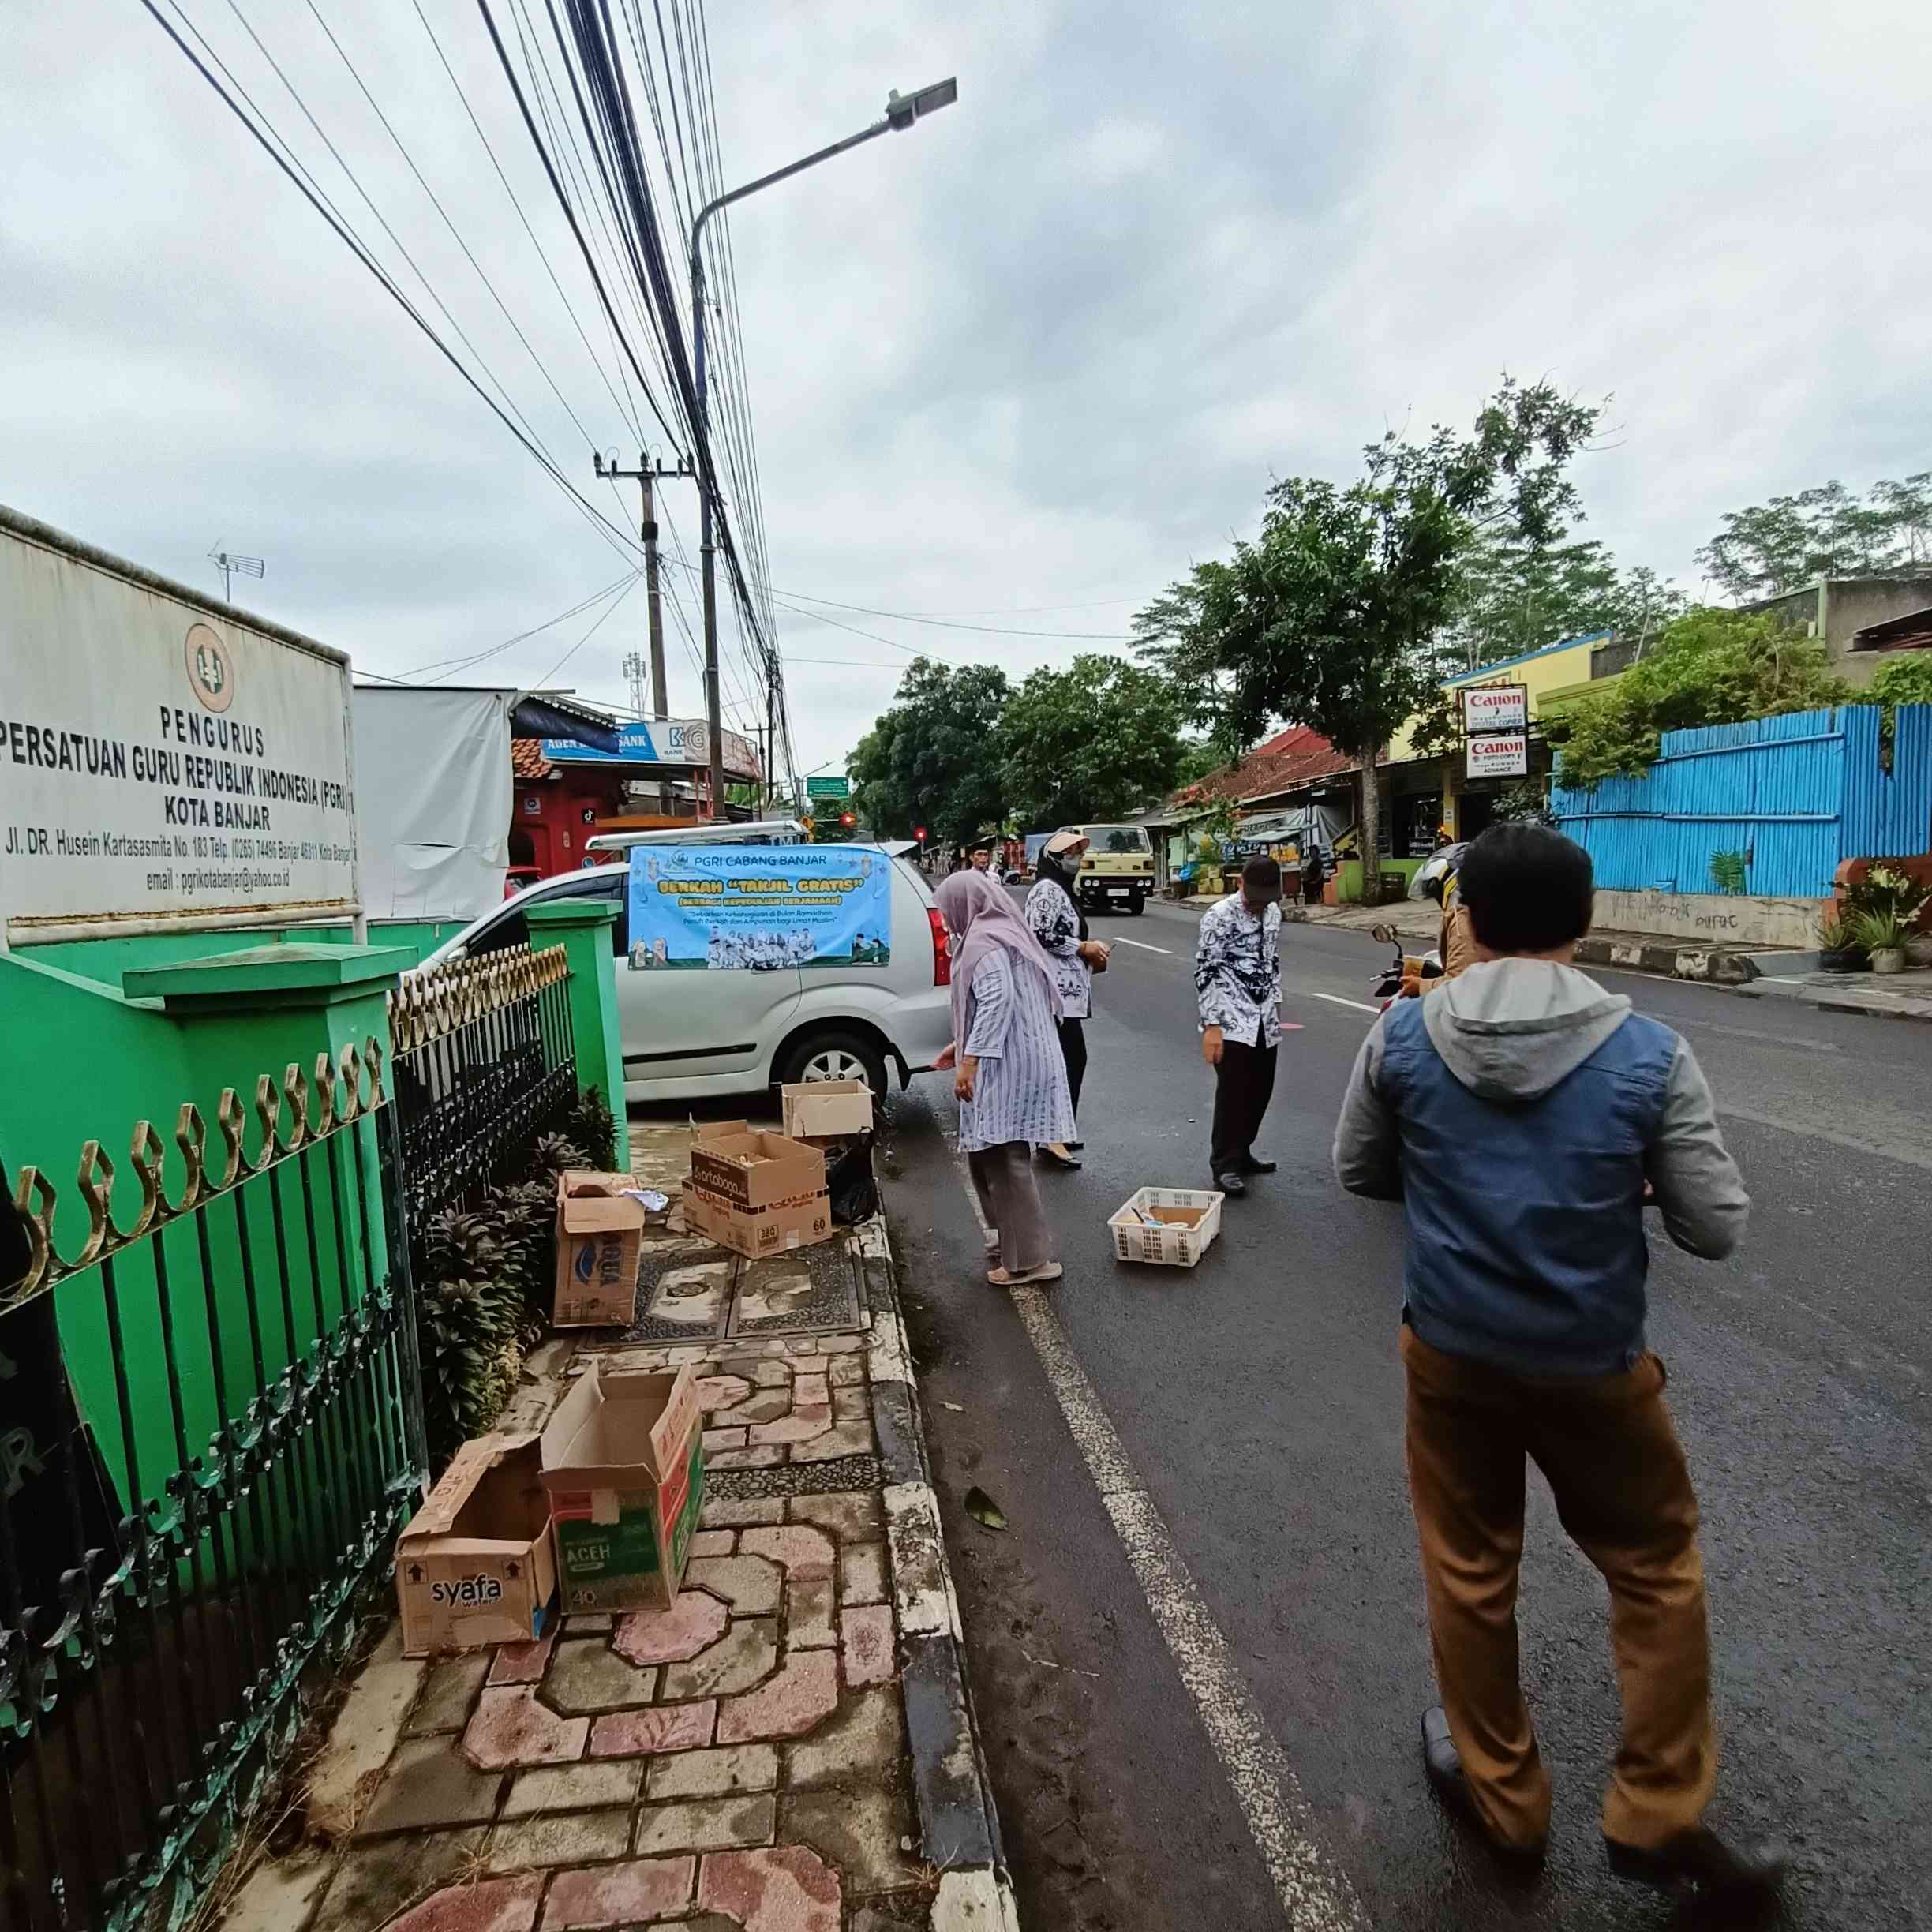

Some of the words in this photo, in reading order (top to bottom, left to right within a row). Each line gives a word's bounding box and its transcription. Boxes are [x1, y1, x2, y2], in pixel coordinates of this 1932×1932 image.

[1470, 695, 1522, 706] Canon
[160, 706, 264, 758] PENGURUS
[1471, 742, 1523, 754] Canon
[132, 745, 181, 787] GURU
[185, 754, 256, 796] REPUBLIK
[257, 767, 319, 806] INDONESIA
[164, 795, 211, 827] KOTA
[214, 800, 271, 831] BANJAR
[27, 827, 53, 856] DR.
[56, 829, 100, 856] Husein
[103, 831, 173, 858] Kartasasmita
[174, 835, 190, 859] No.
[193, 836, 208, 859] 183
[232, 838, 255, 863] (0265)
[278, 841, 300, 864] Banjar
[695, 856, 723, 867] PGRI
[725, 855, 777, 867] CABANG
[779, 855, 827, 865] BANJAR
[147, 868, 173, 890] email
[181, 867, 290, 894] pgrikotabanjar@yahoo.co.id
[813, 1219, 826, 1231] 60
[567, 1544, 611, 1563] ACEH
[432, 1574, 502, 1608] syafa
